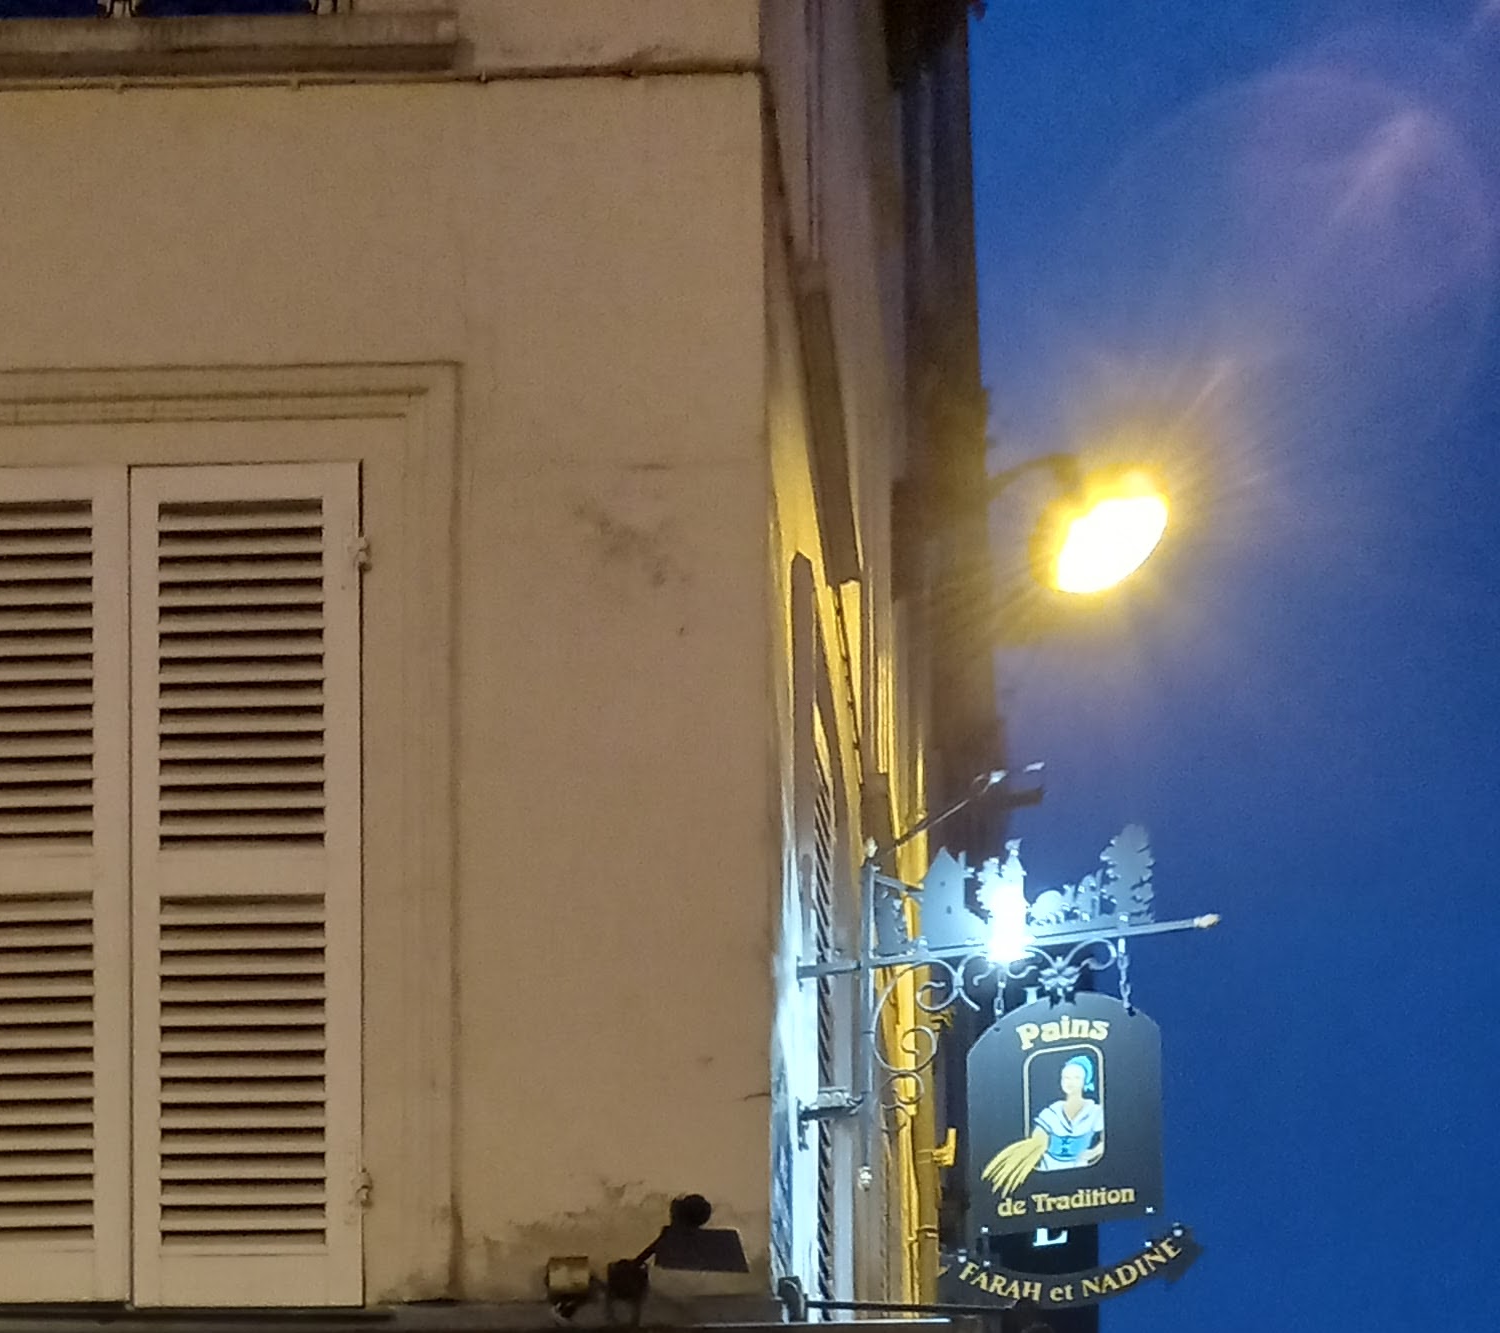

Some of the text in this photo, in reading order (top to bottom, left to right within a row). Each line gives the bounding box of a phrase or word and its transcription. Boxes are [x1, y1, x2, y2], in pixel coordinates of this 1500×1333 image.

[1016, 1015, 1111, 1050] Pains
[997, 1187, 1136, 1217] de Tradition
[958, 1237, 1182, 1302] FARAH et NADINE
